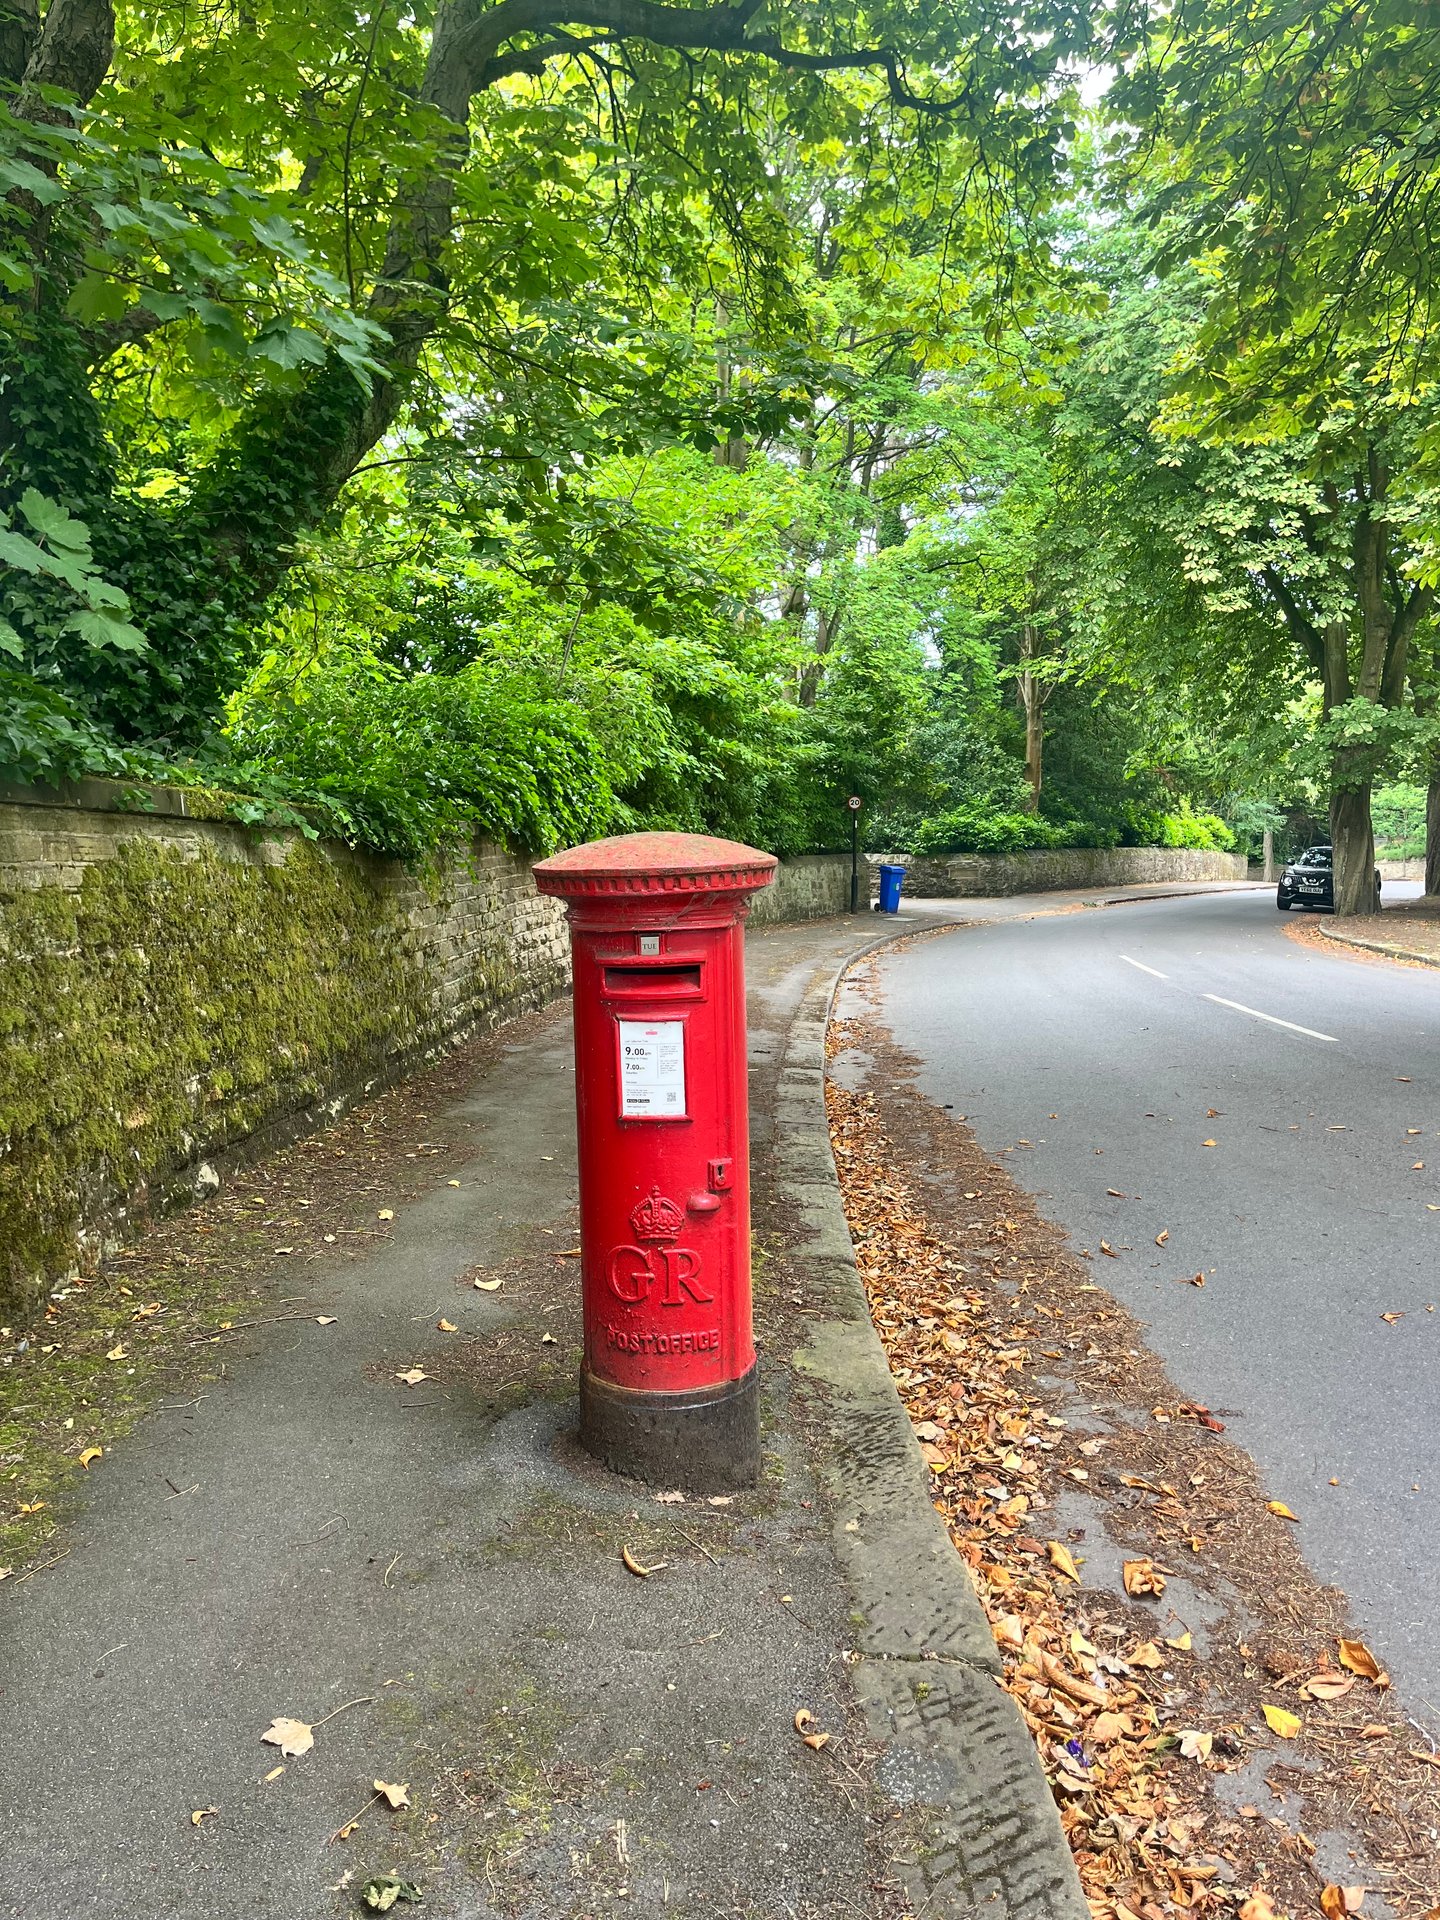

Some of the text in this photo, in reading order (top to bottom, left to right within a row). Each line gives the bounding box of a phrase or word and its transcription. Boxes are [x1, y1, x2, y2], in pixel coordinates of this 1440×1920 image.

[606, 1245, 714, 1305] GR
[607, 1329, 719, 1355] POST OFFICE
